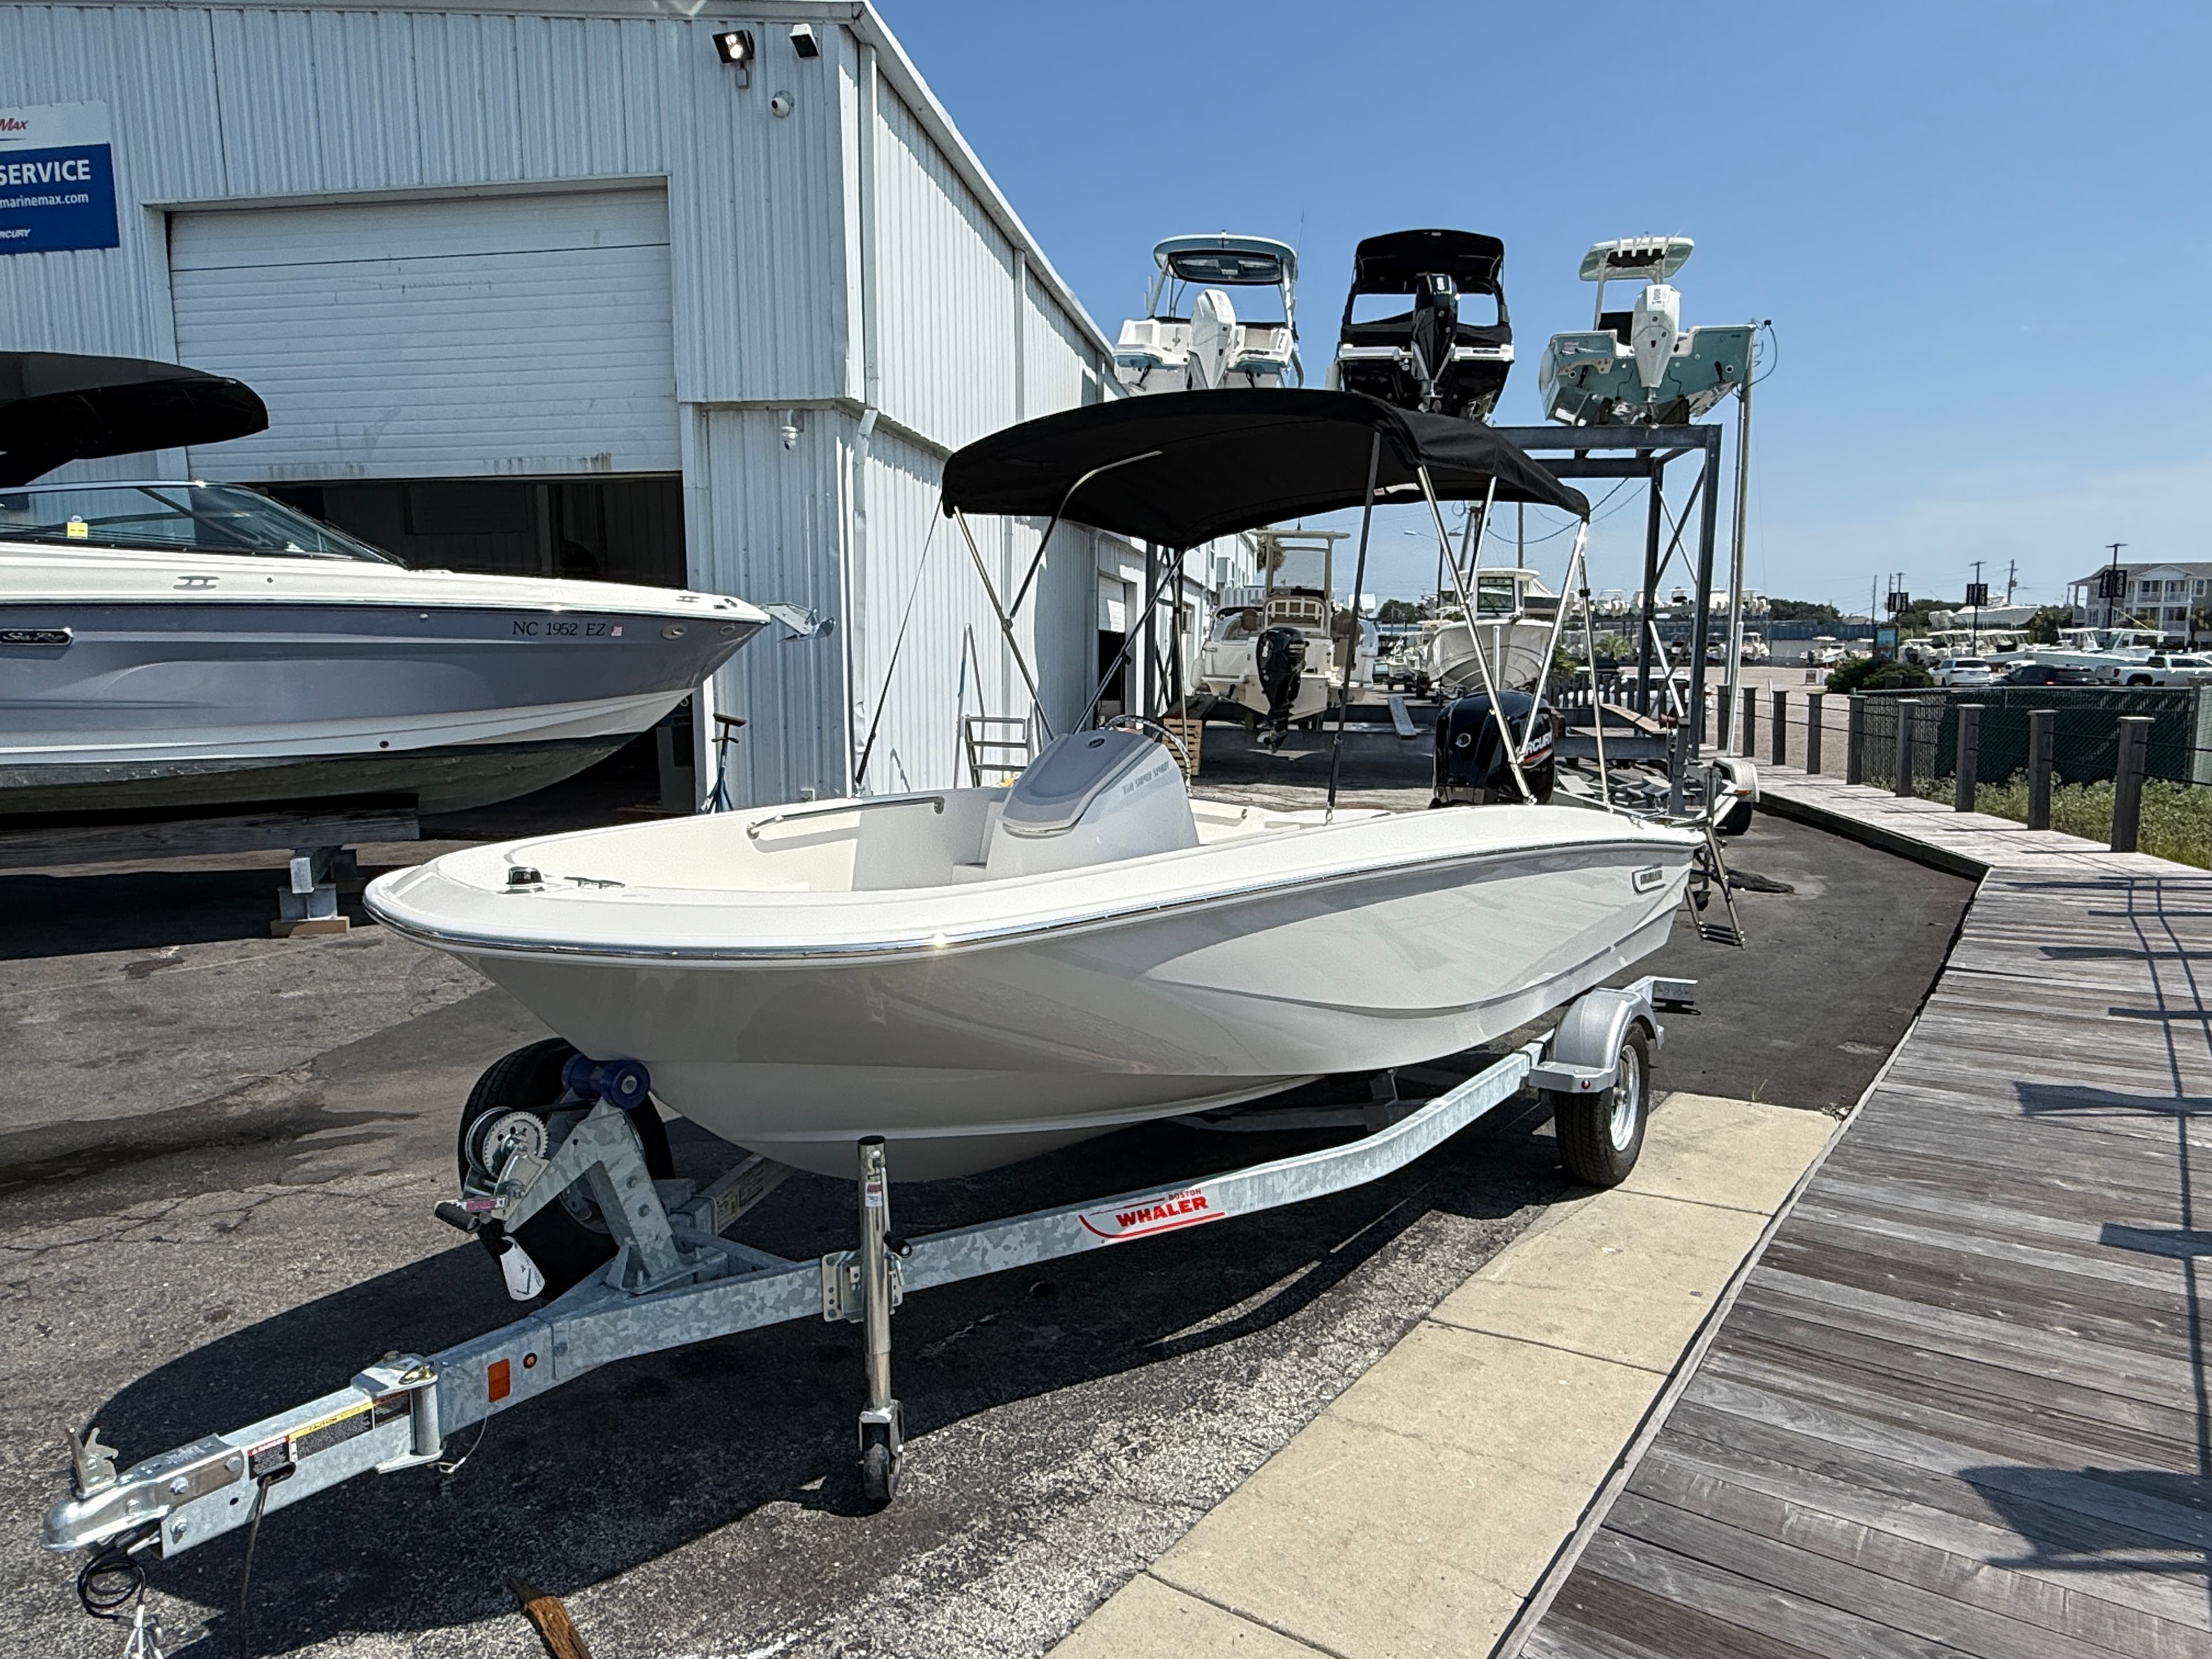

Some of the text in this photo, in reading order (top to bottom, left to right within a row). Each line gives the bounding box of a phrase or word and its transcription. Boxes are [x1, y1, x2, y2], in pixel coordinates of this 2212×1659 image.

[0, 159, 91, 185] SERVICE
[0, 193, 89, 209] marinemax.com
[512, 621, 539, 635] NC
[546, 622, 578, 636] 1952
[585, 623, 606, 636] EZ
[1168, 1188, 1202, 1200] BOSTON
[1115, 1196, 1209, 1228] WHALER
